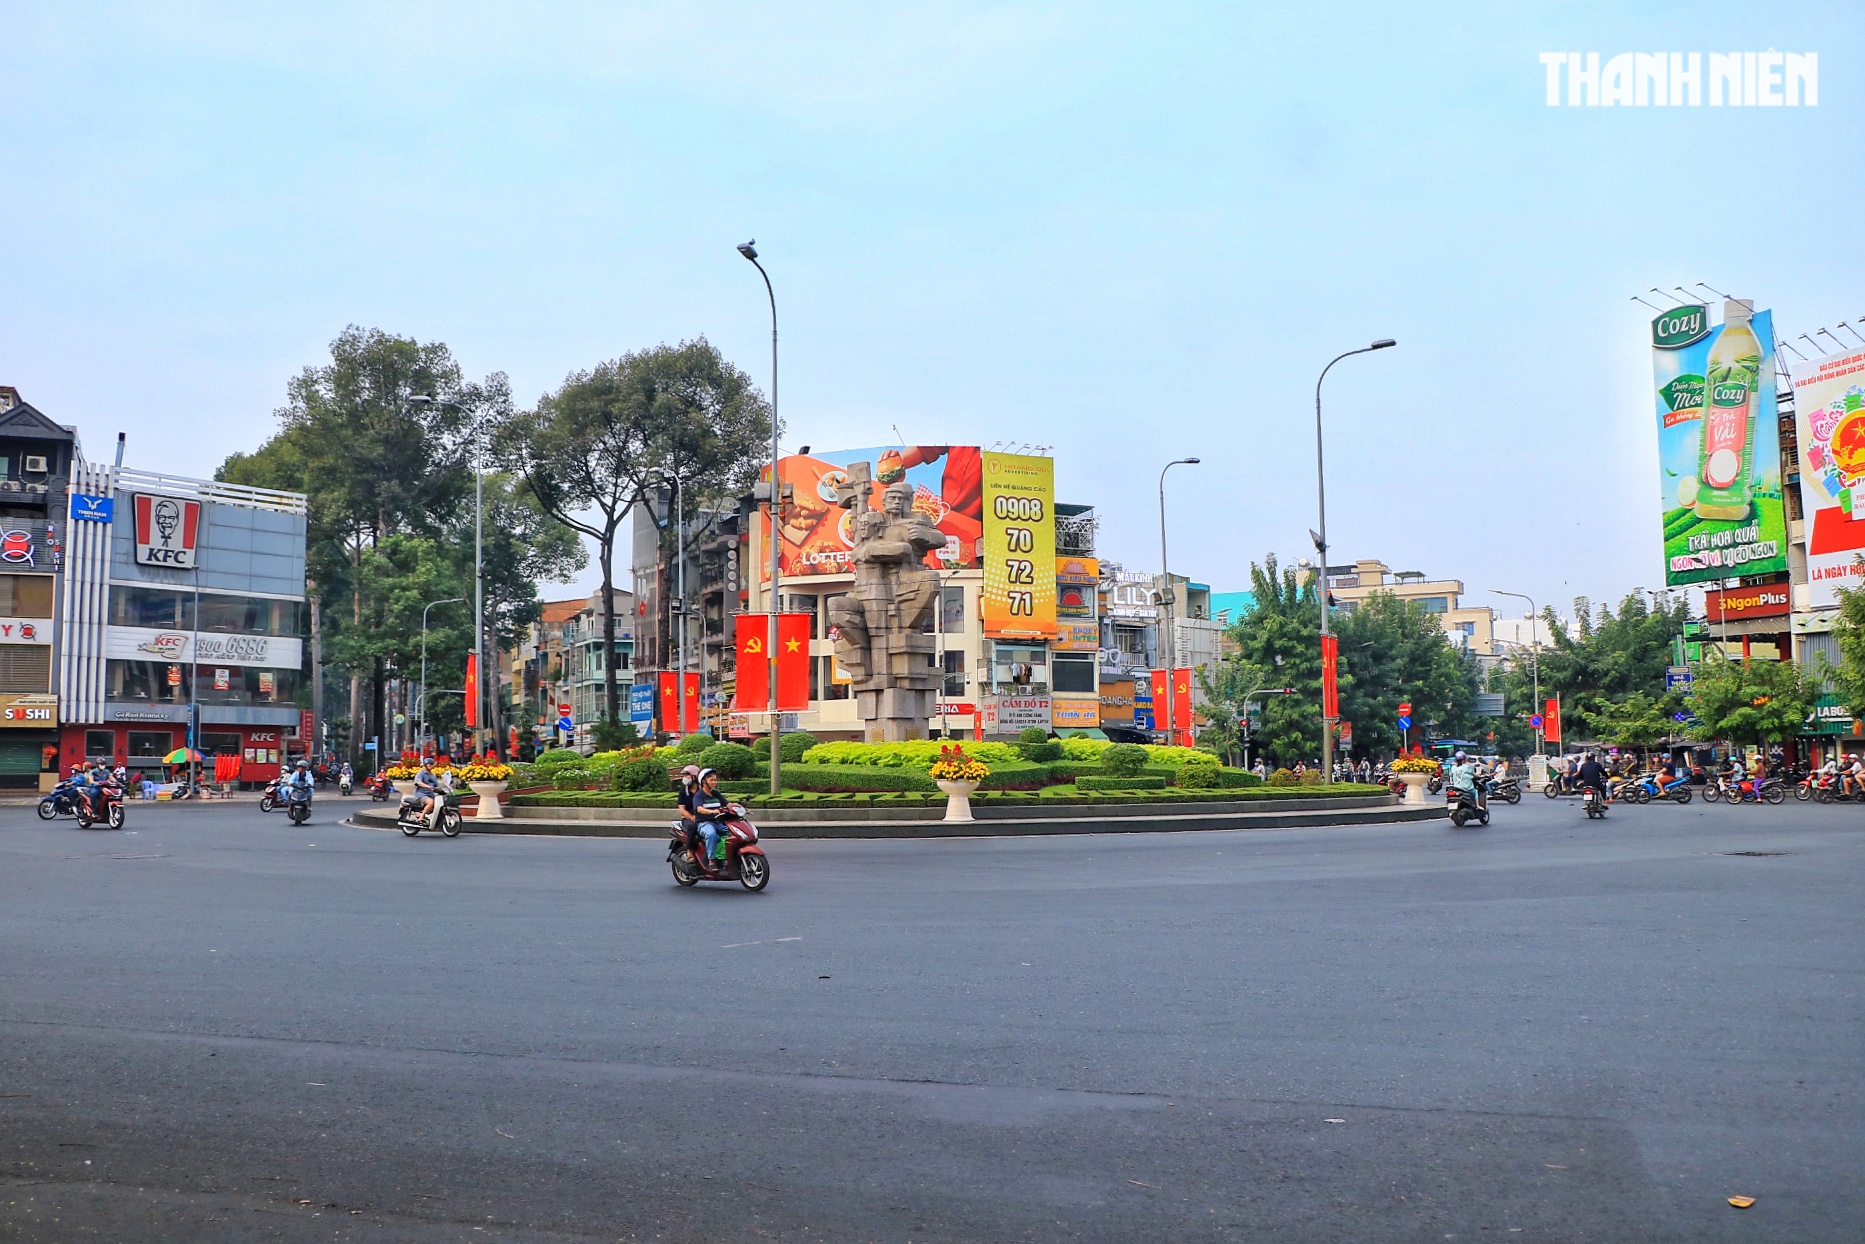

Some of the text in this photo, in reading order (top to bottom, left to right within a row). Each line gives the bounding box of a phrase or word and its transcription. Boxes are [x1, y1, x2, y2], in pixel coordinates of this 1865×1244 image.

[1657, 312, 1700, 337] Cozy
[1714, 387, 1744, 403] Cozy
[1714, 422, 1737, 442] Vải
[994, 495, 1044, 522] 0908
[1005, 527, 1033, 553] 70
[1687, 519, 1759, 552] TRÀ HOA QUẢ
[146, 547, 187, 564] KFC
[1671, 557, 1693, 570] NGON
[1709, 551, 1720, 566] VỊ
[1723, 549, 1734, 567] VỊ
[1750, 542, 1775, 558] NGON
[1006, 559, 1034, 584] 72
[1811, 566, 1823, 581] LÀ
[1824, 564, 1847, 580] NGÀY
[1007, 590, 1033, 617] 71
[1113, 587, 1157, 606] LILY
[1072, 627, 1097, 635] EPOXY
[155, 636, 180, 647] KFC
[225, 635, 268, 656] 6886
[631, 700, 652, 711] THE ONE
[1038, 700, 1049, 708] T2
[4, 708, 50, 720] SUSHI
[987, 712, 995, 722] T2
[250, 733, 275, 742] KFC
